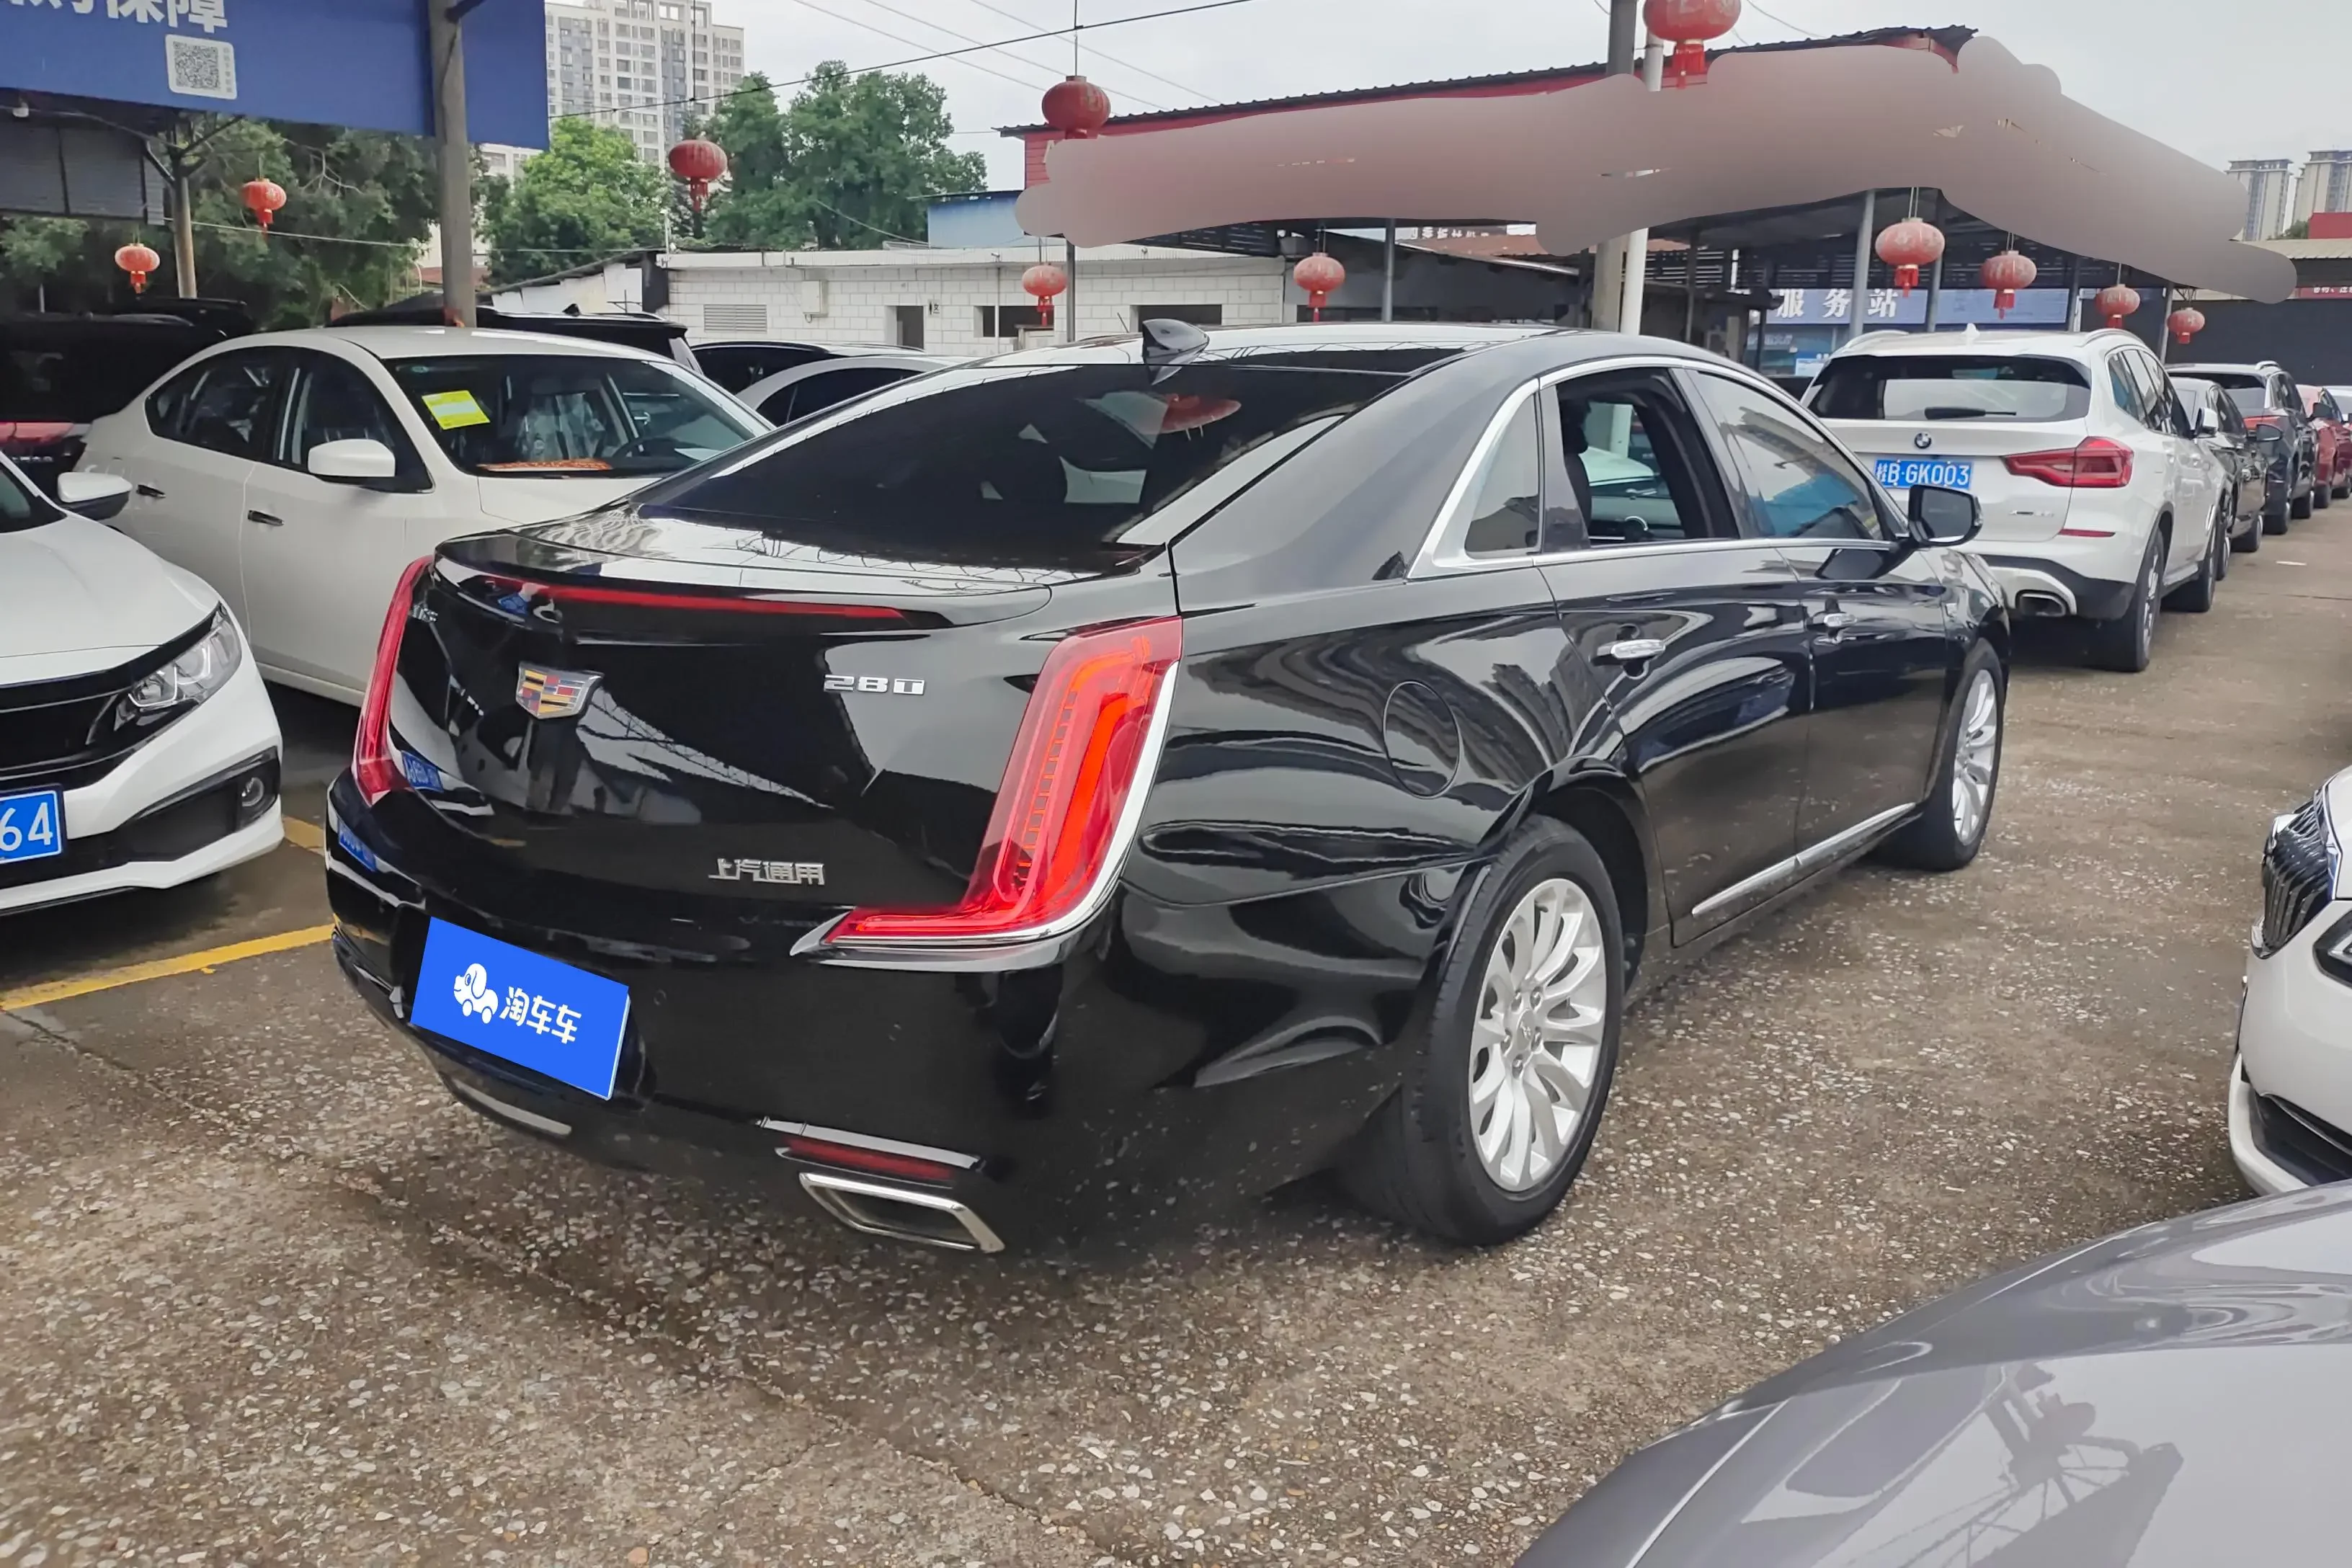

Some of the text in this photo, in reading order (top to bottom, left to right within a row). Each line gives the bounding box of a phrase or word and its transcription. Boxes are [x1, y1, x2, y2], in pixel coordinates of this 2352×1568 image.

[1777, 288, 1898, 318] 服务站
[824, 674, 925, 695] 28T
[0, 802, 53, 851] 64
[708, 858, 825, 885] 上汽通用
